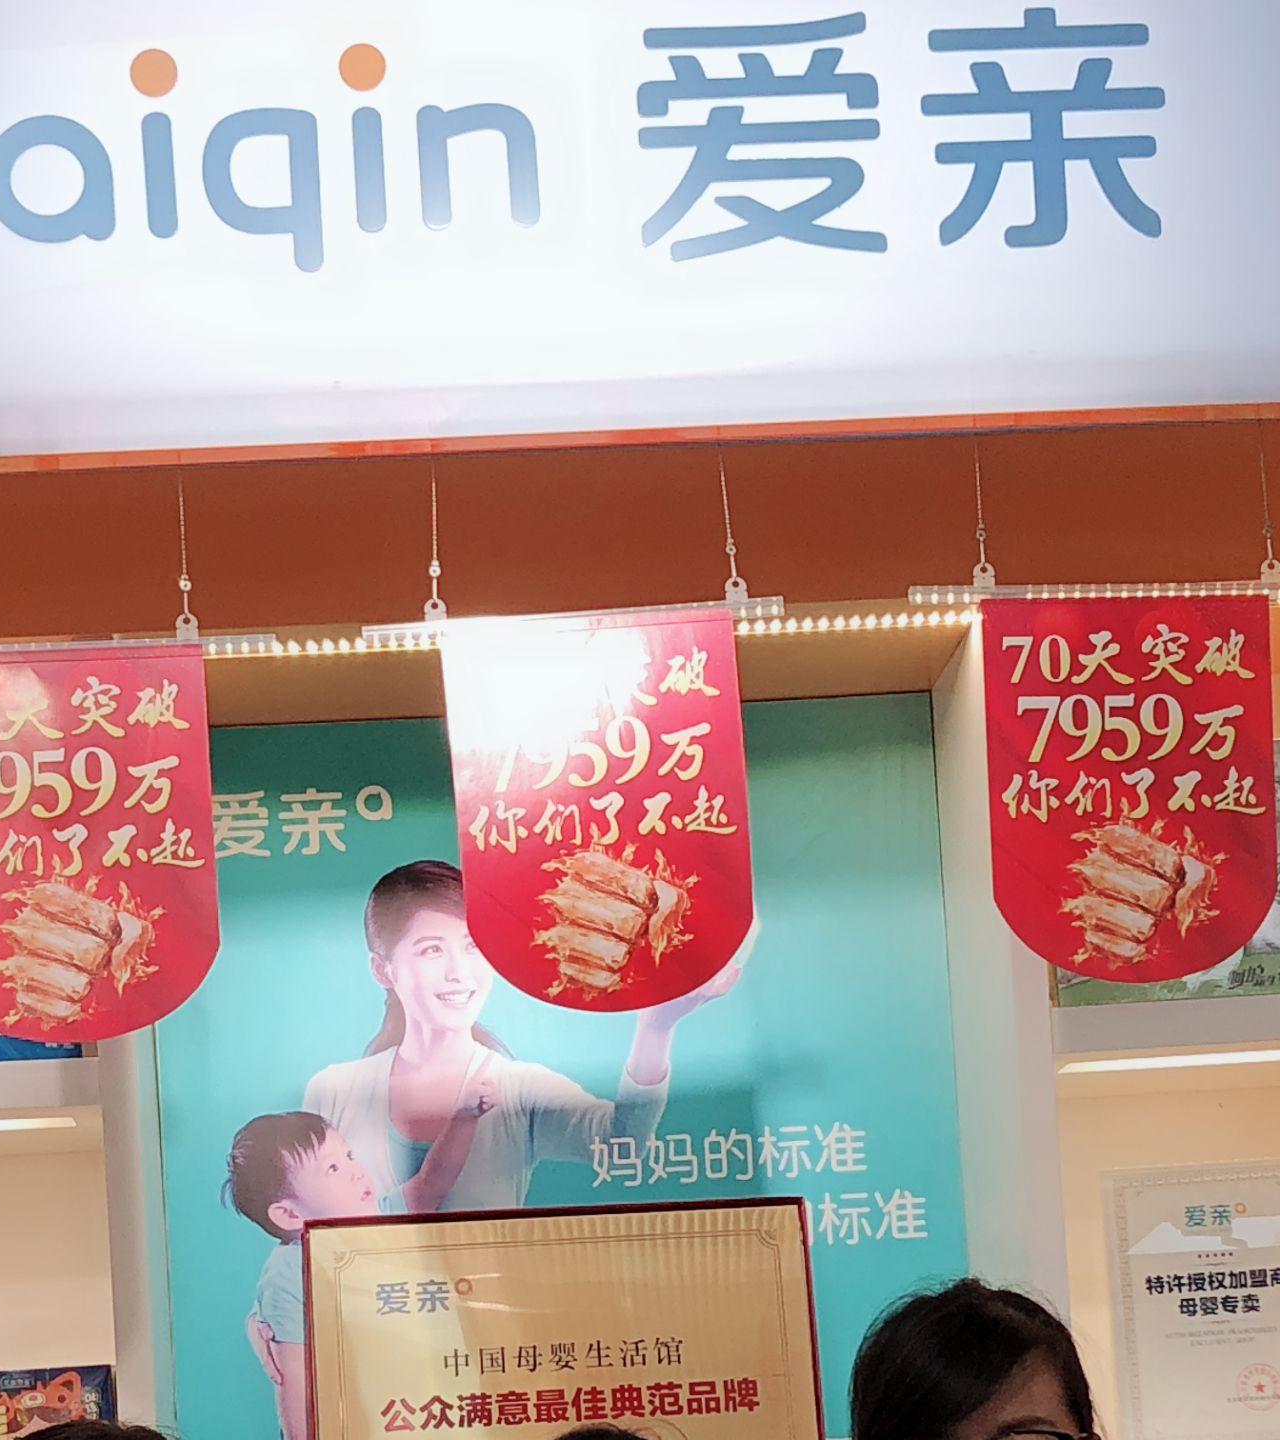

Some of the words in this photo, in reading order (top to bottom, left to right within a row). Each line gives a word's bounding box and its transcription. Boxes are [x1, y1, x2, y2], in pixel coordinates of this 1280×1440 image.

[636, 7, 1166, 262] 爱亲
[1001, 623, 1257, 686] 70天突破
[1016, 694, 1245, 764] 7959万
[213, 783, 349, 858] 爱亲
[467, 784, 739, 855] 你们了不起
[1000, 764, 1267, 823] 你们了不起
[590, 1120, 868, 1188] 妈妈的标准
[806, 1187, 929, 1246] 标准
[1183, 1203, 1232, 1228] 爱亲
[375, 1278, 451, 1316] 爱亲
[1178, 1293, 1261, 1317] 母婴专卖
[442, 1335, 685, 1378] 中国母婴生活馆
[380, 1376, 761, 1434] 公众满意最佳典范品牌
